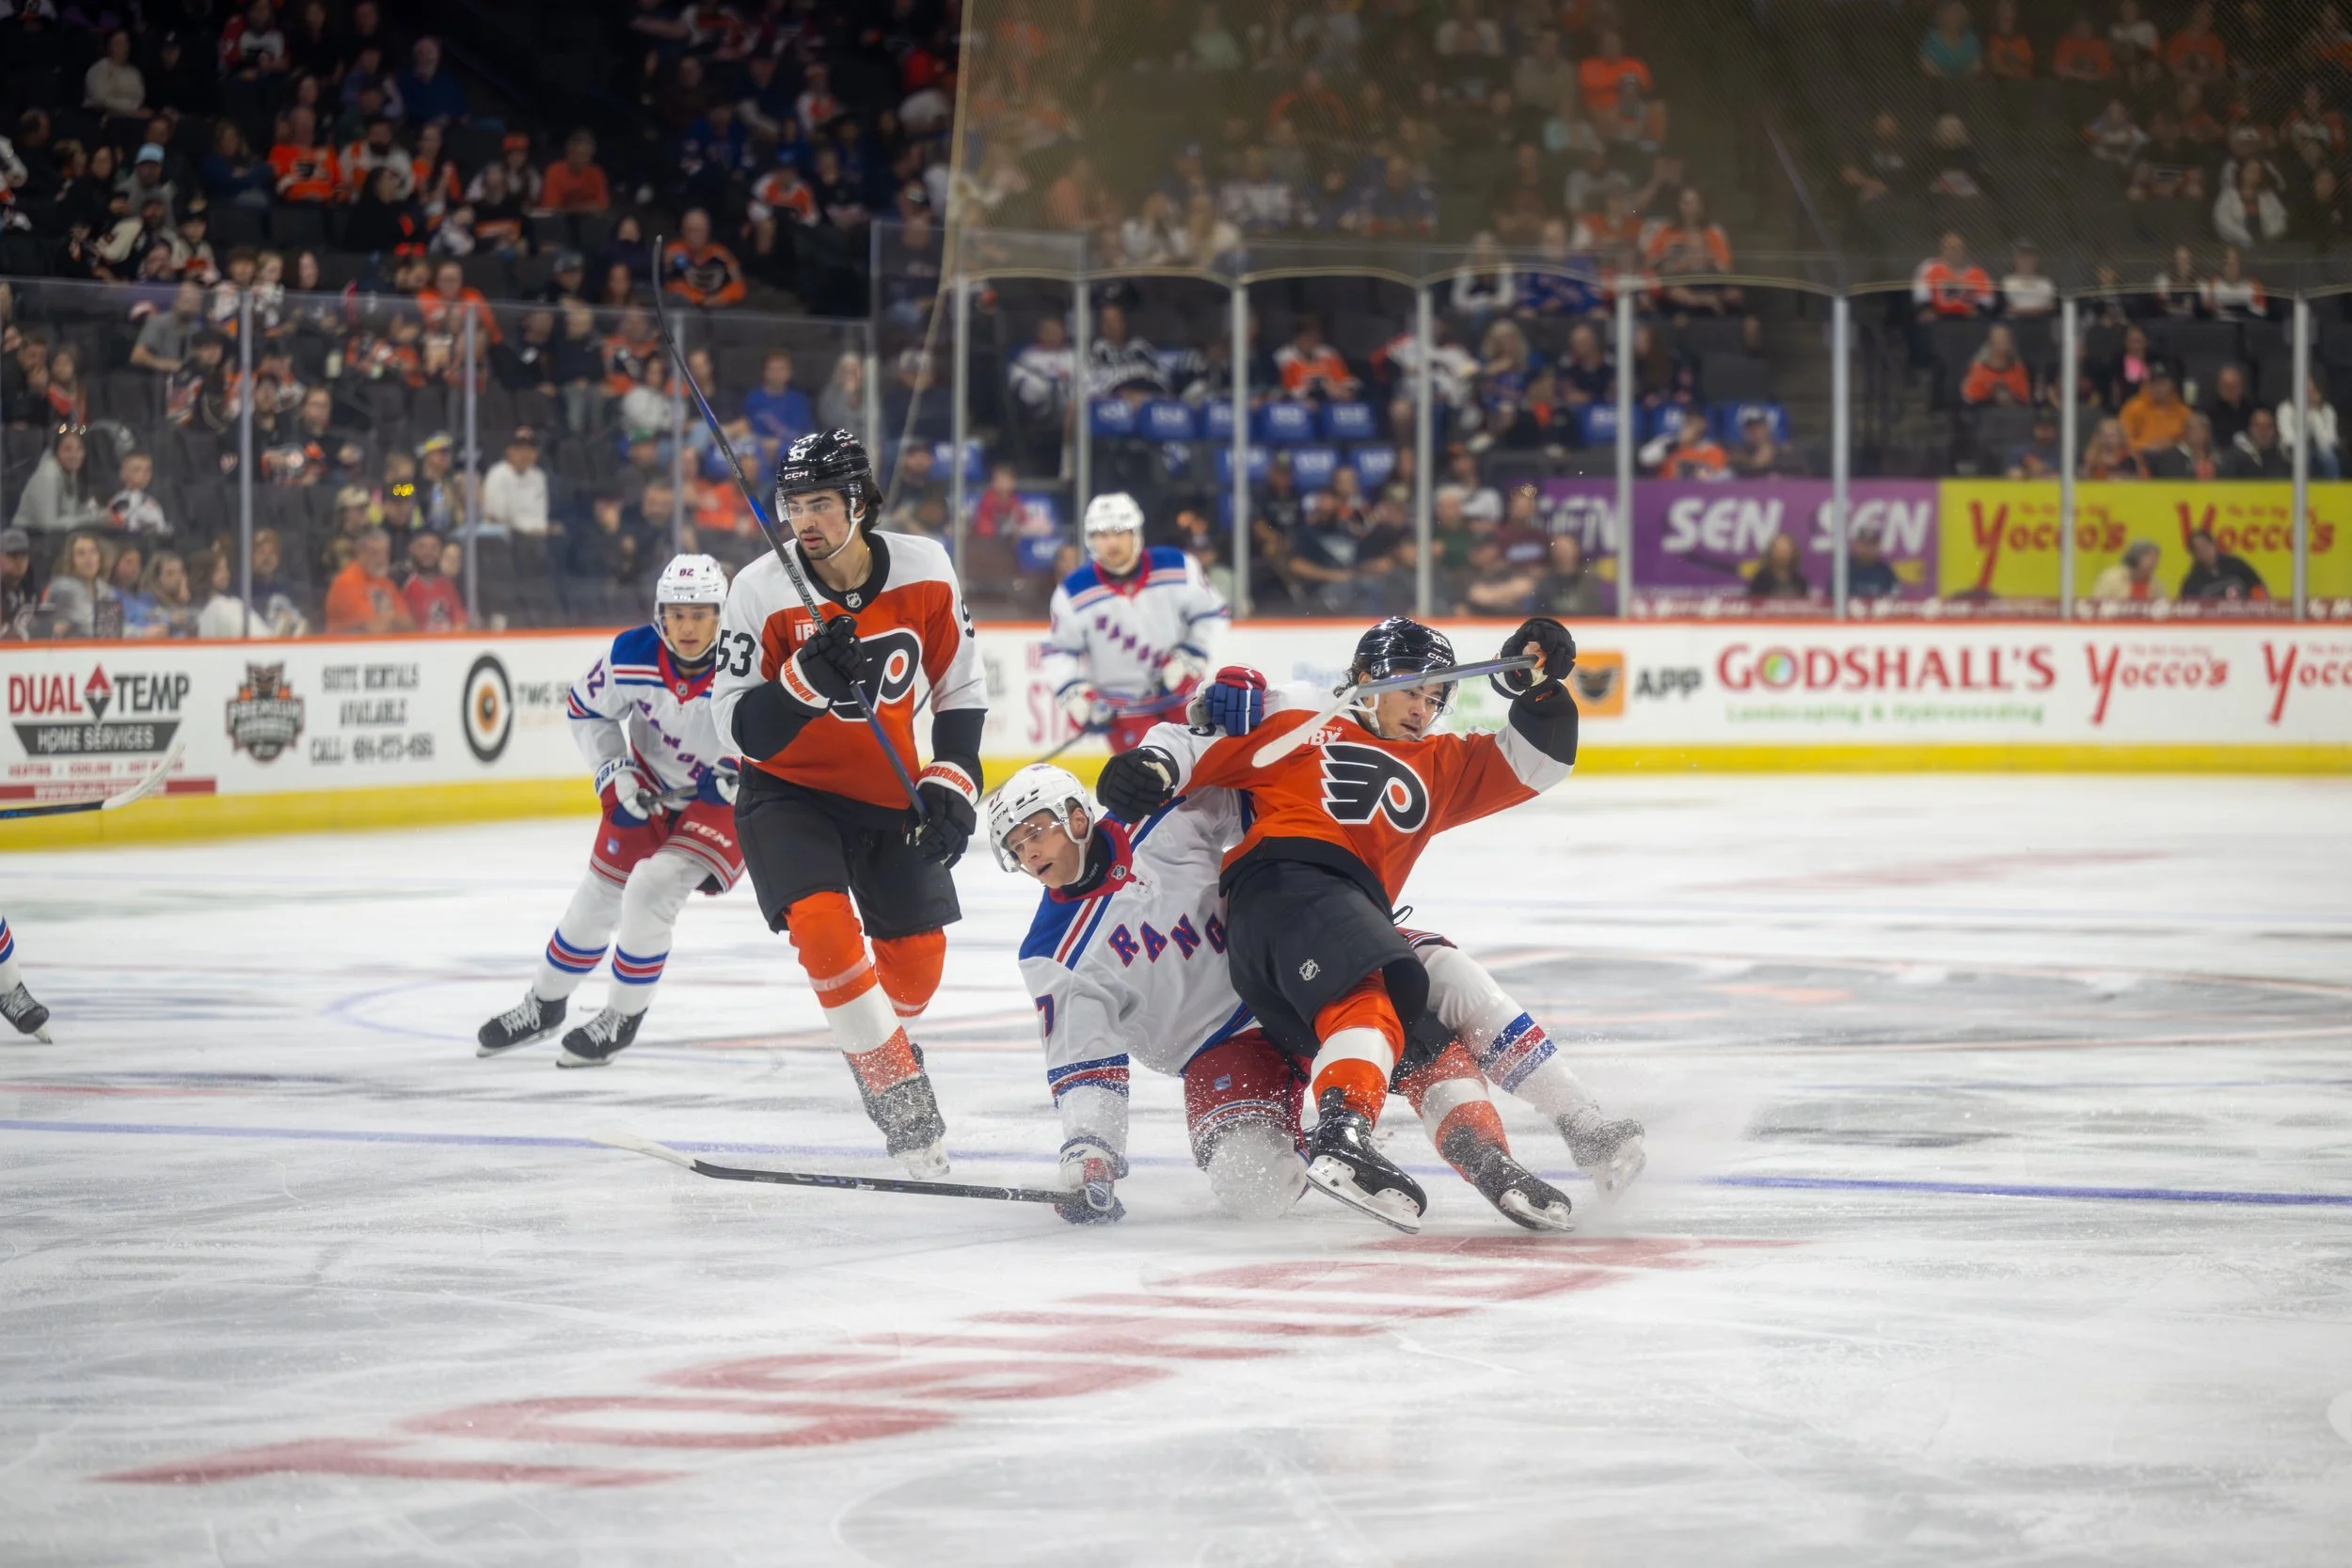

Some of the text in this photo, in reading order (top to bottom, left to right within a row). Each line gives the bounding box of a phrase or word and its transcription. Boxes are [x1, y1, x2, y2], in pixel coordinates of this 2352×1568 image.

[784, 470, 809, 481] CCM
[1661, 496, 1785, 553] SEN
[678, 567, 695, 578] 82
[716, 629, 756, 678] 53
[1427, 651, 1453, 668] CCM
[1716, 641, 2057, 693] GODSHALL'S
[8, 672, 191, 714] DUAL TEMP
[1634, 665, 1702, 702] APP
[2084, 641, 2228, 724] Yocco's
[38, 724, 155, 752] HOME SERVICES
[89, 1235, 1812, 1488] TOSHIBA
